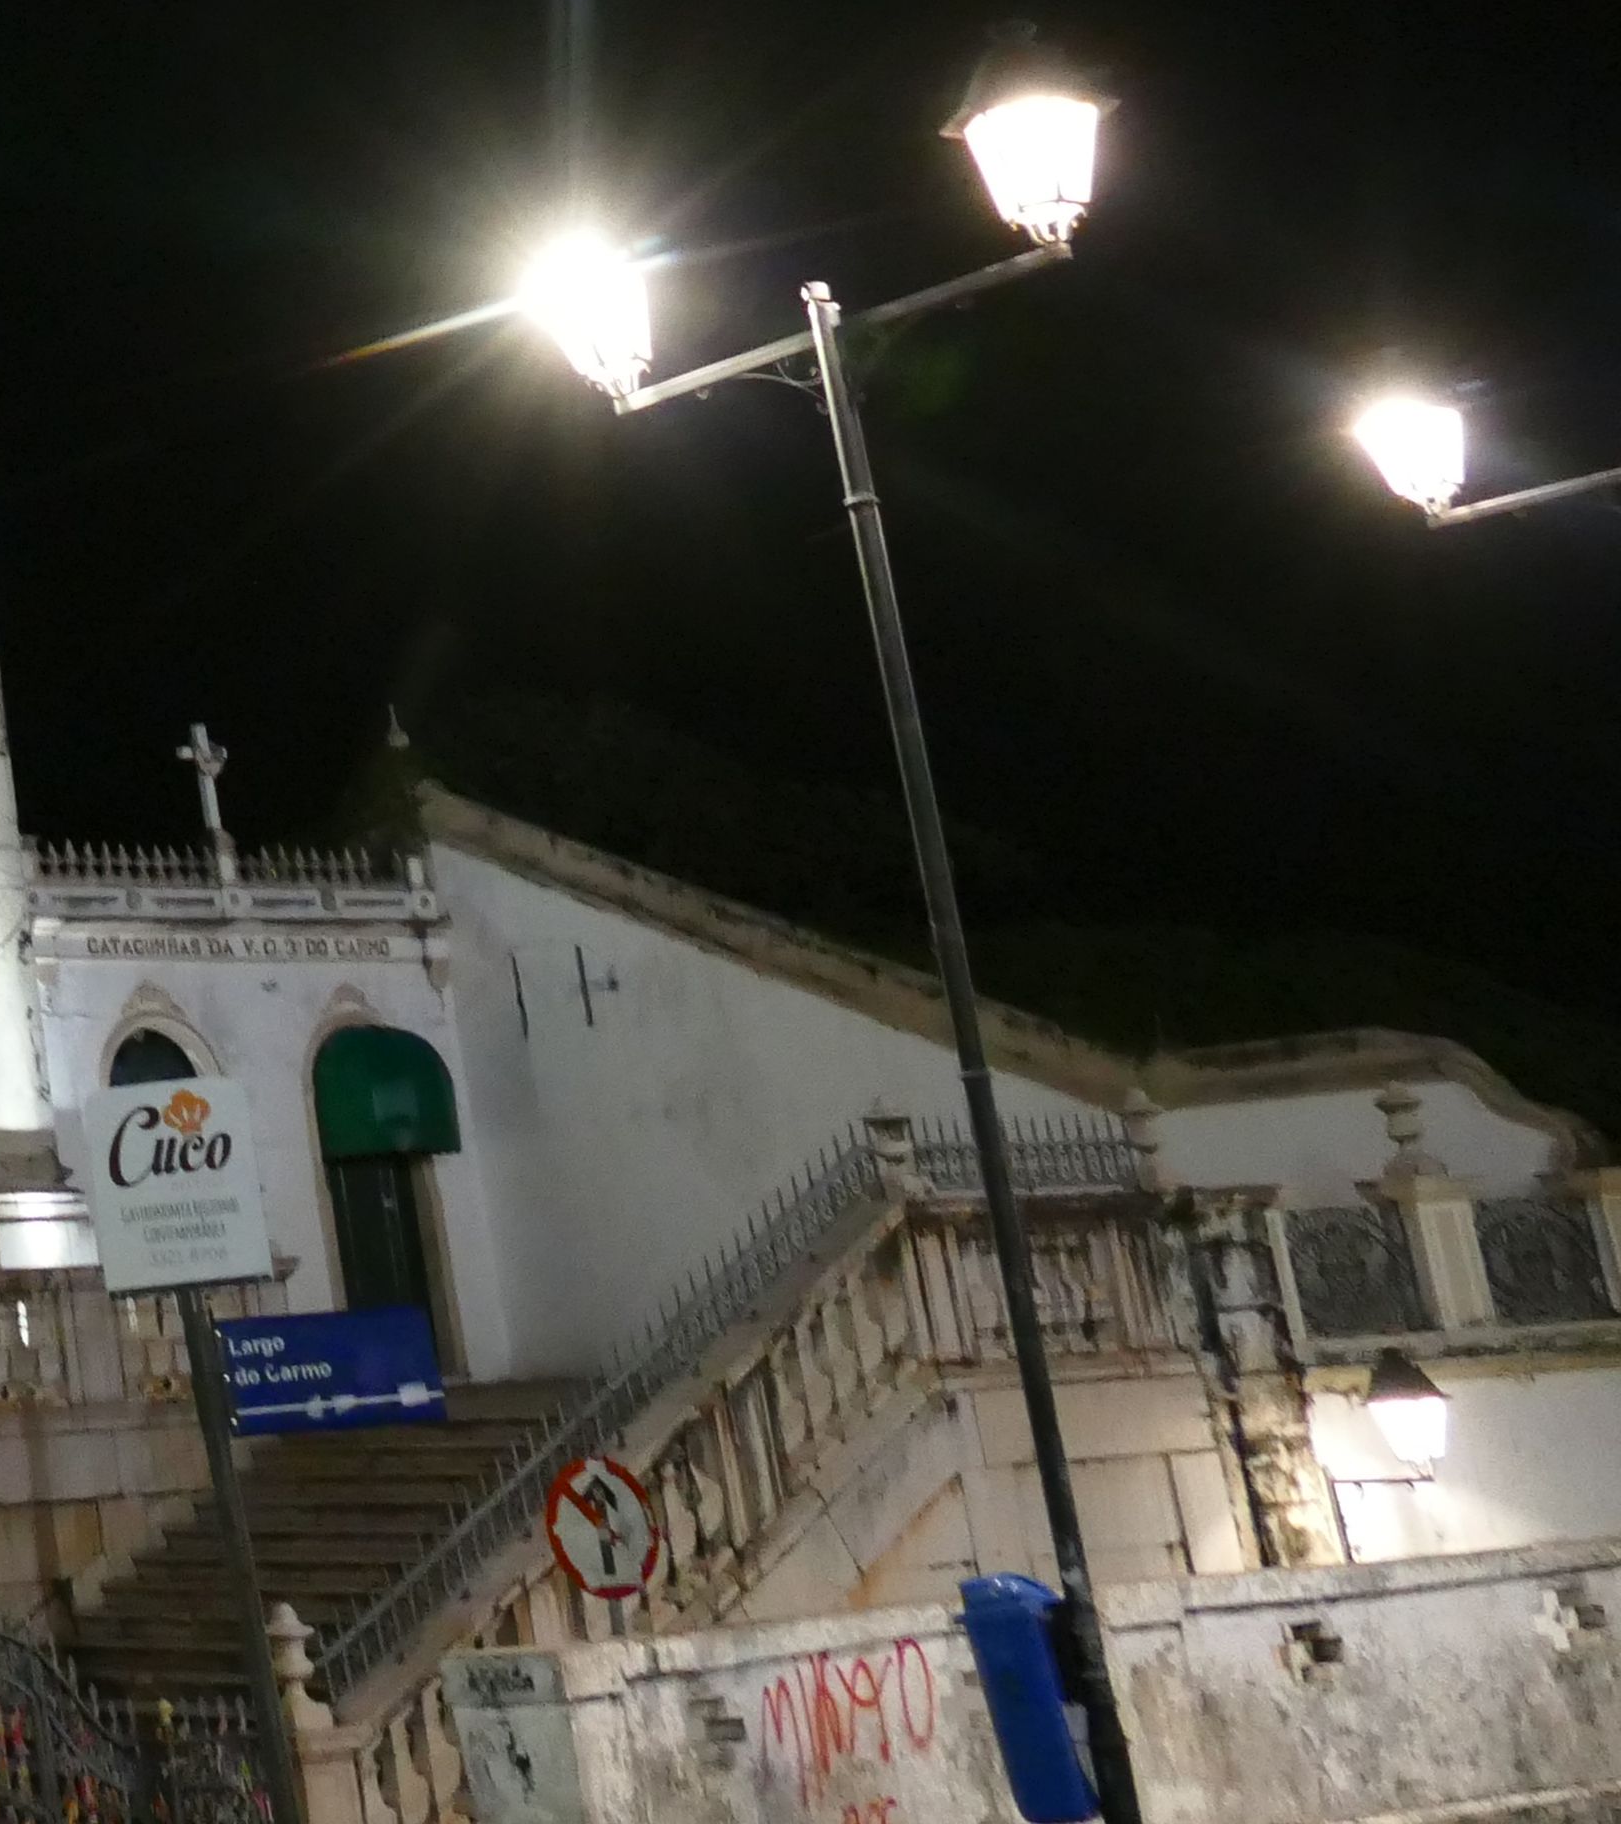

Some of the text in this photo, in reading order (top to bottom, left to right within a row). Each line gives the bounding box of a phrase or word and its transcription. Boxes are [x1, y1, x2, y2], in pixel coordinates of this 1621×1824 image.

[207, 936, 234, 956] DA
[305, 937, 329, 956] DO
[109, 1106, 232, 1187] Cuco
[227, 1336, 285, 1357] Largo
[235, 1361, 332, 1387] do Carmo
